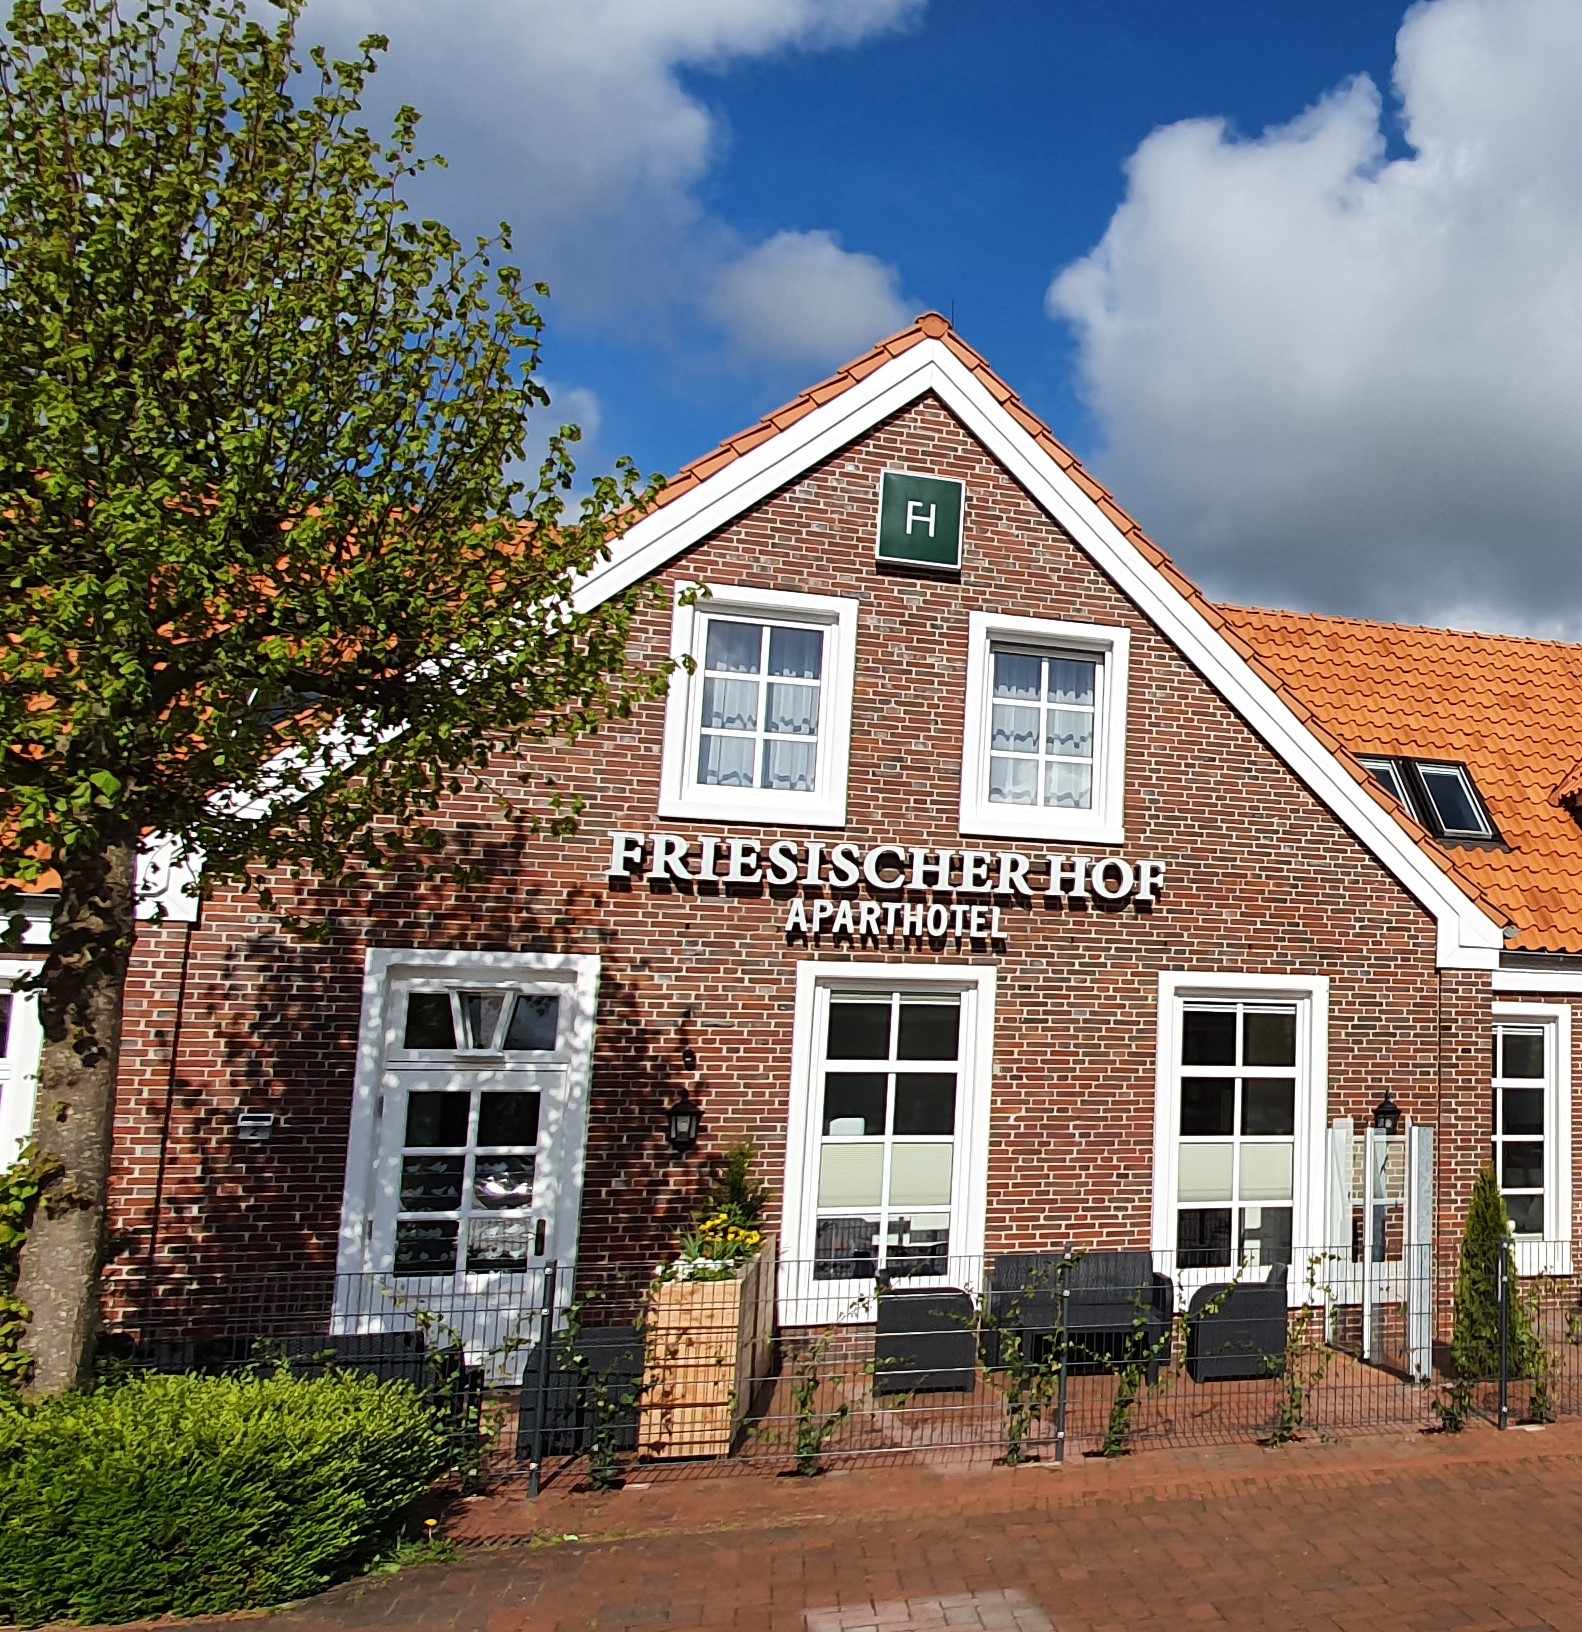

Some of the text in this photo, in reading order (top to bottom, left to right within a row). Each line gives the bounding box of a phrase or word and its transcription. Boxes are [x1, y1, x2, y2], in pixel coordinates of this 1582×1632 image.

[604, 831, 1166, 900] FRIESISCHER HOF
[785, 899, 1008, 938] APARTHOTEL
